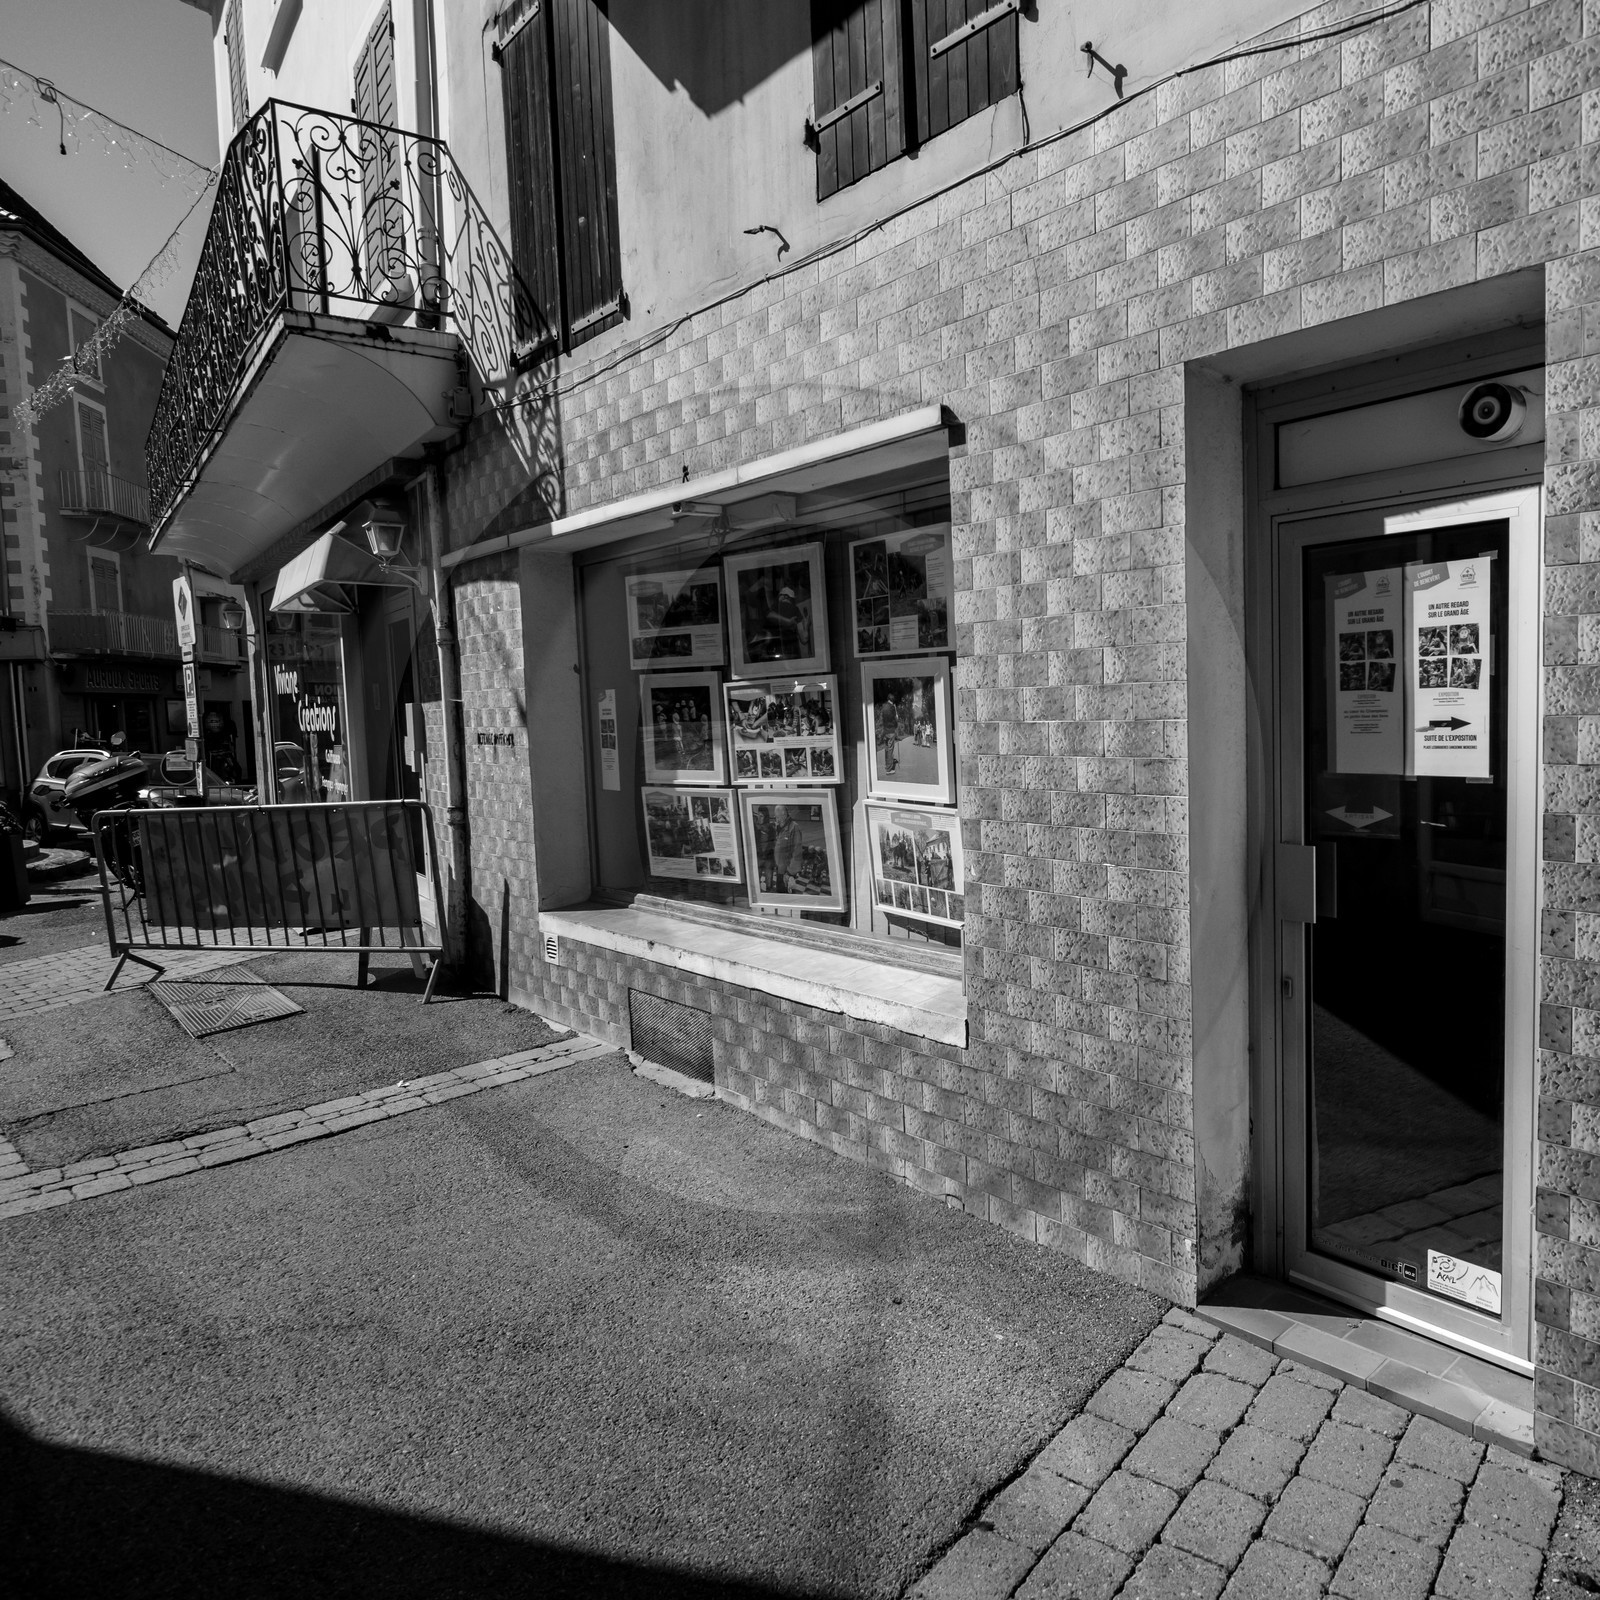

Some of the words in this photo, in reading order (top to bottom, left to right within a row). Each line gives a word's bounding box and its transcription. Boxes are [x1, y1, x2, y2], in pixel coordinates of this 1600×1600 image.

[1435, 602, 1450, 610] AUTRE
[1450, 600, 1470, 608] REGARD
[1443, 609, 1459, 617] GRAND
[86, 667, 126, 689] AUROUX
[127, 669, 160, 690] SPORTS
[274, 664, 298, 703] Viviane
[298, 693, 336, 742] Créations
[1423, 734, 1437, 742] SUITE
